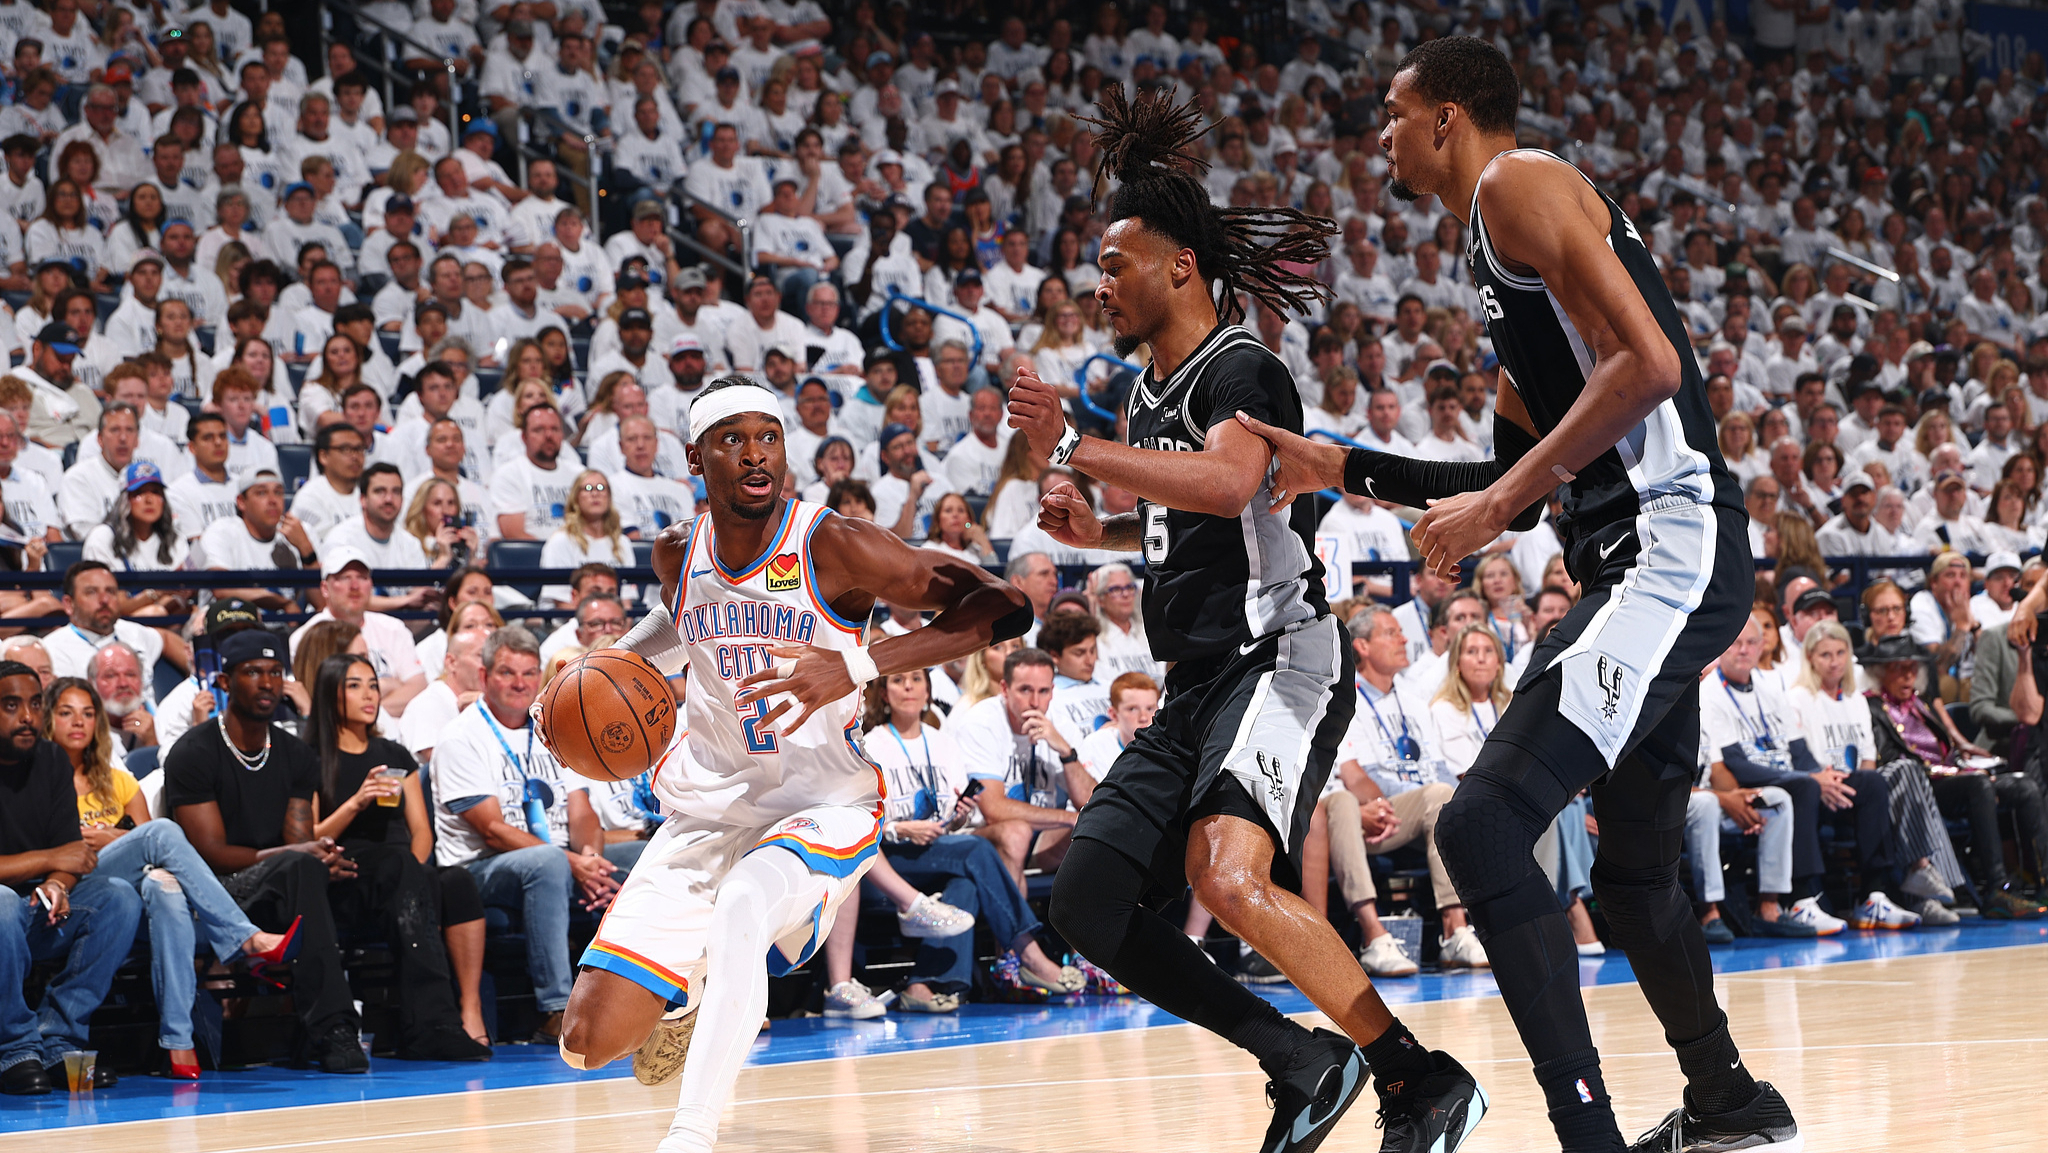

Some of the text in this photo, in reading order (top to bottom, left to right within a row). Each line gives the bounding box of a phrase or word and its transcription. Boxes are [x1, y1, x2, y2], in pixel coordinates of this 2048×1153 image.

[1144, 502, 1170, 565] 5
[681, 601, 817, 645] OKLAHOMA
[716, 643, 774, 680] CITY
[734, 686, 779, 754] 2
